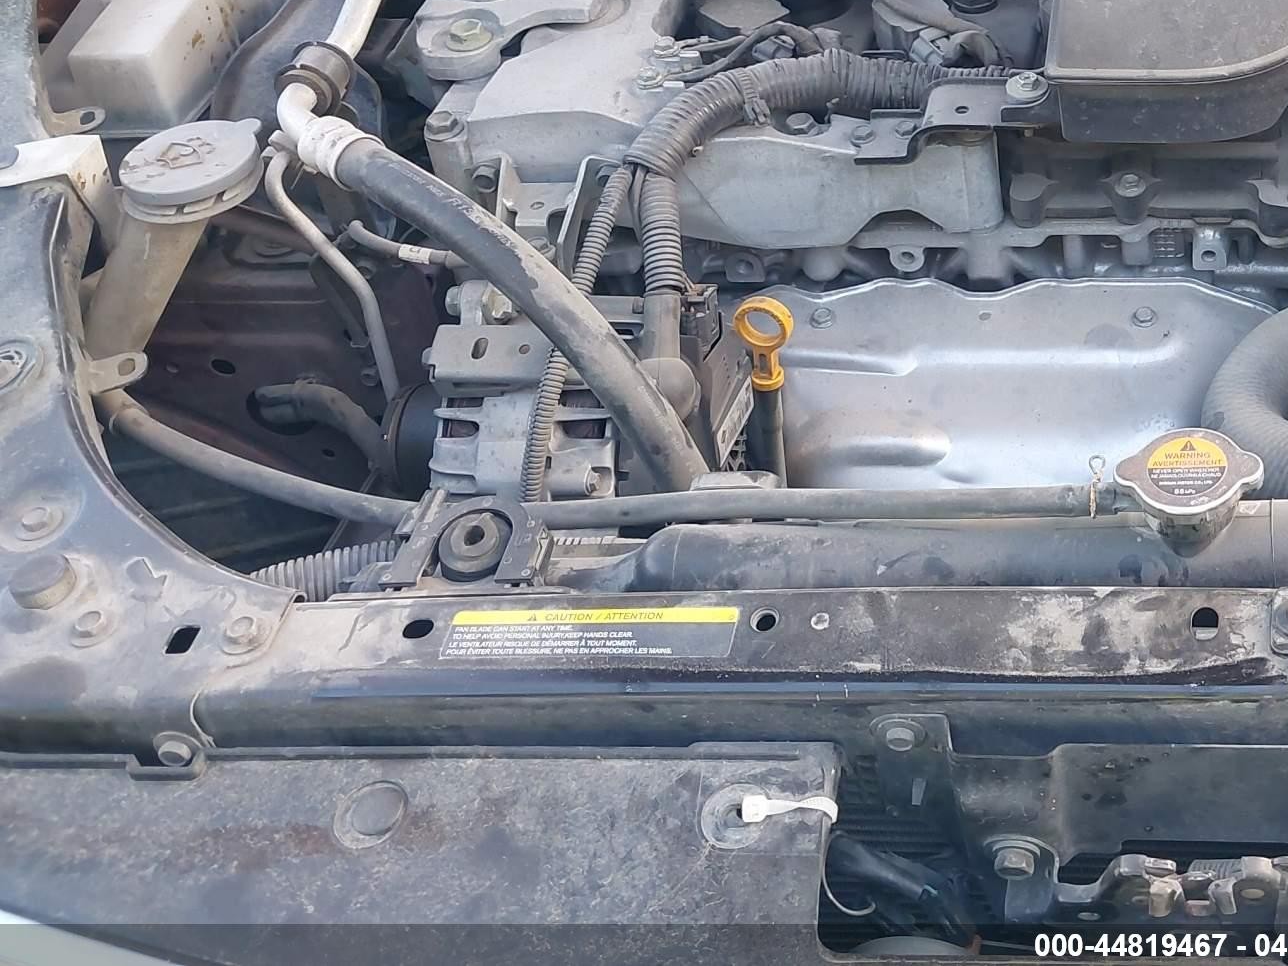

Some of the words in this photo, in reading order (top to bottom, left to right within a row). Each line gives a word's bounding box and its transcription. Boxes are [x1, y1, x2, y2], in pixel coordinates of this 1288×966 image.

[1164, 451, 1211, 459] WARNING
[1152, 459, 1223, 467] AVERTISSEMENT
[544, 612, 593, 622] CAUTION
[603, 611, 664, 621] ATTENTION
[467, 647, 491, 655] ÉVITER
